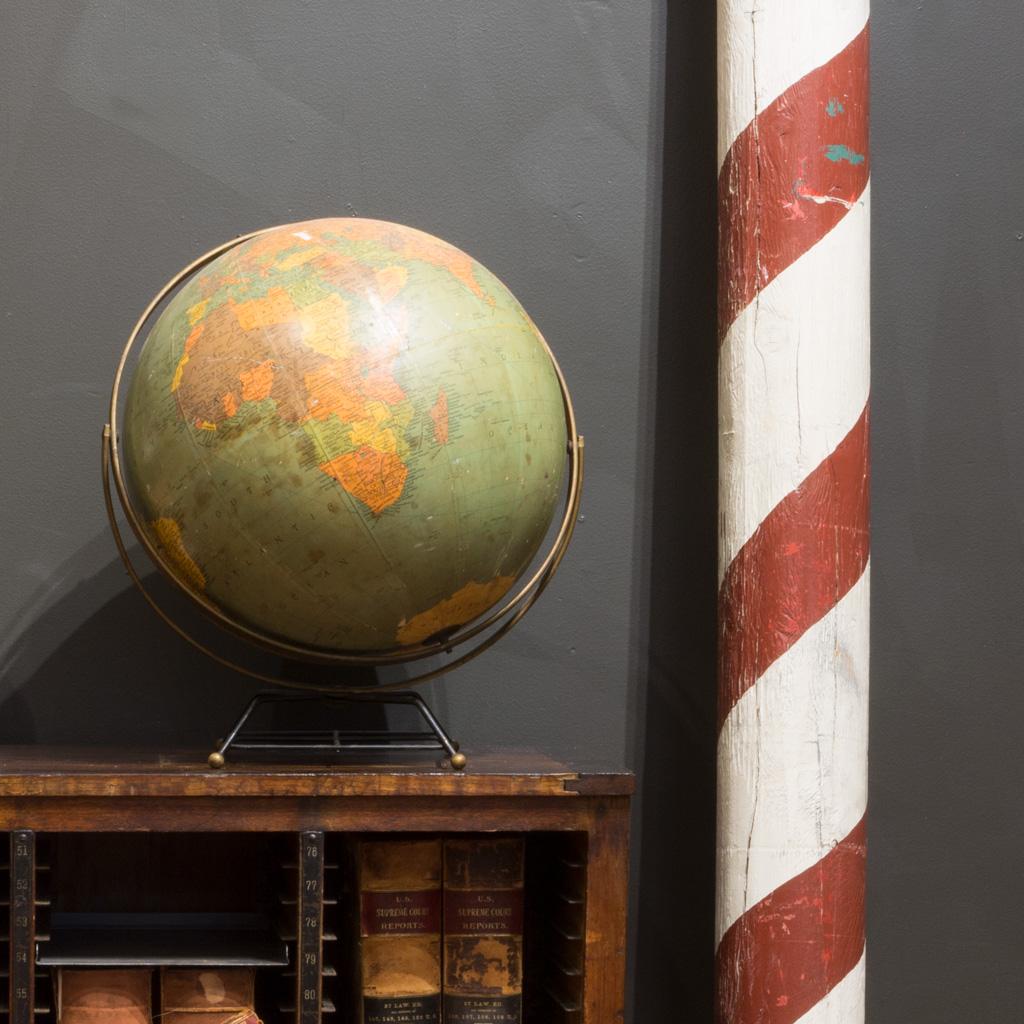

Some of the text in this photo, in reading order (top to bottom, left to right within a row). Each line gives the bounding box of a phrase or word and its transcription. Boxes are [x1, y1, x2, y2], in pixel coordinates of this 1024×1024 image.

[16, 845, 28, 856] 51
[306, 846, 318, 857] 76
[306, 880, 317, 891] 77
[305, 916, 317, 927] 78
[305, 953, 316, 965] 79
[304, 989, 316, 1000] 80
